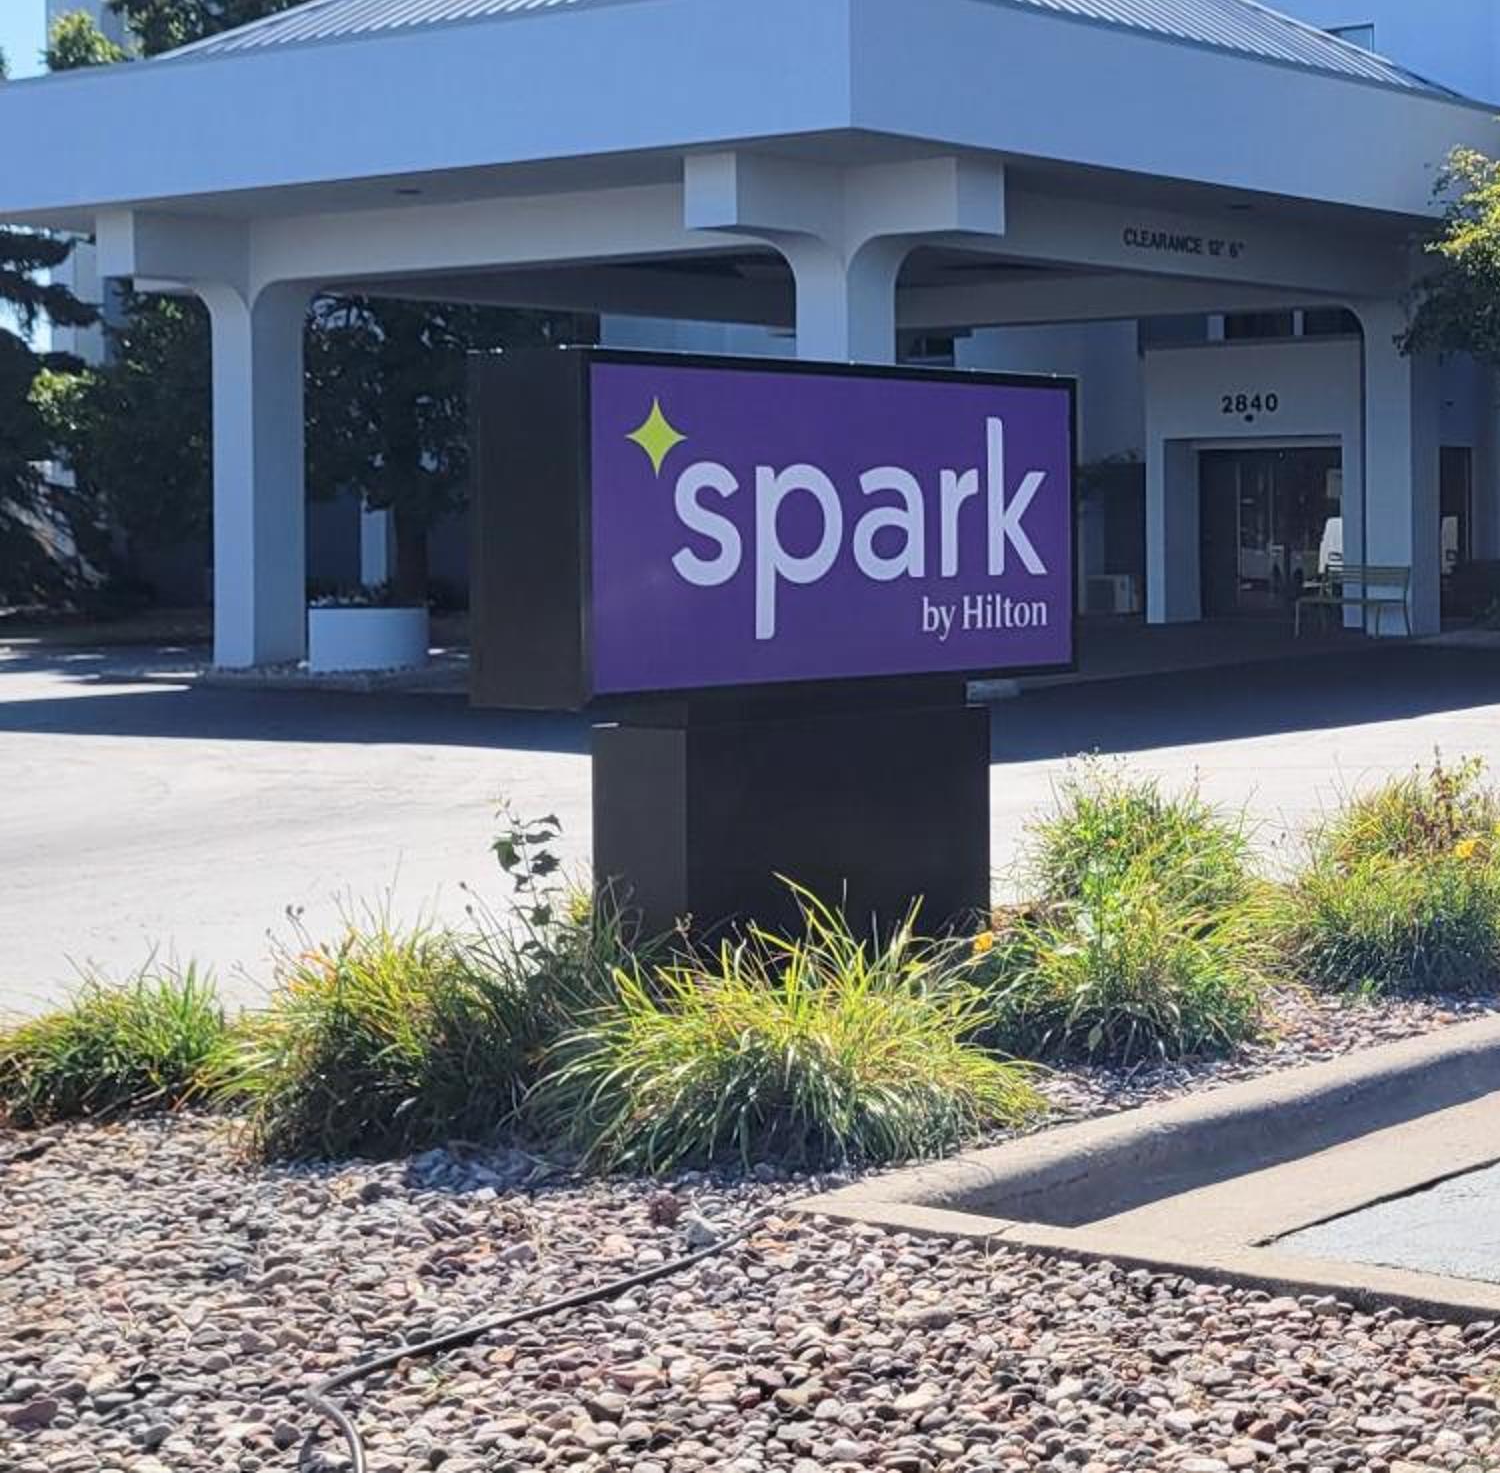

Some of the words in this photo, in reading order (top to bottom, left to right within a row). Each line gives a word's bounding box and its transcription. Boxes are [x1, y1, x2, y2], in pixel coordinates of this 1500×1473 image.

[1123, 228, 1202, 255] CLEARANCE
[1221, 393, 1278, 414] 2840
[671, 416, 1048, 640] spark
[922, 595, 956, 642] by
[961, 593, 1048, 629] Hilton
